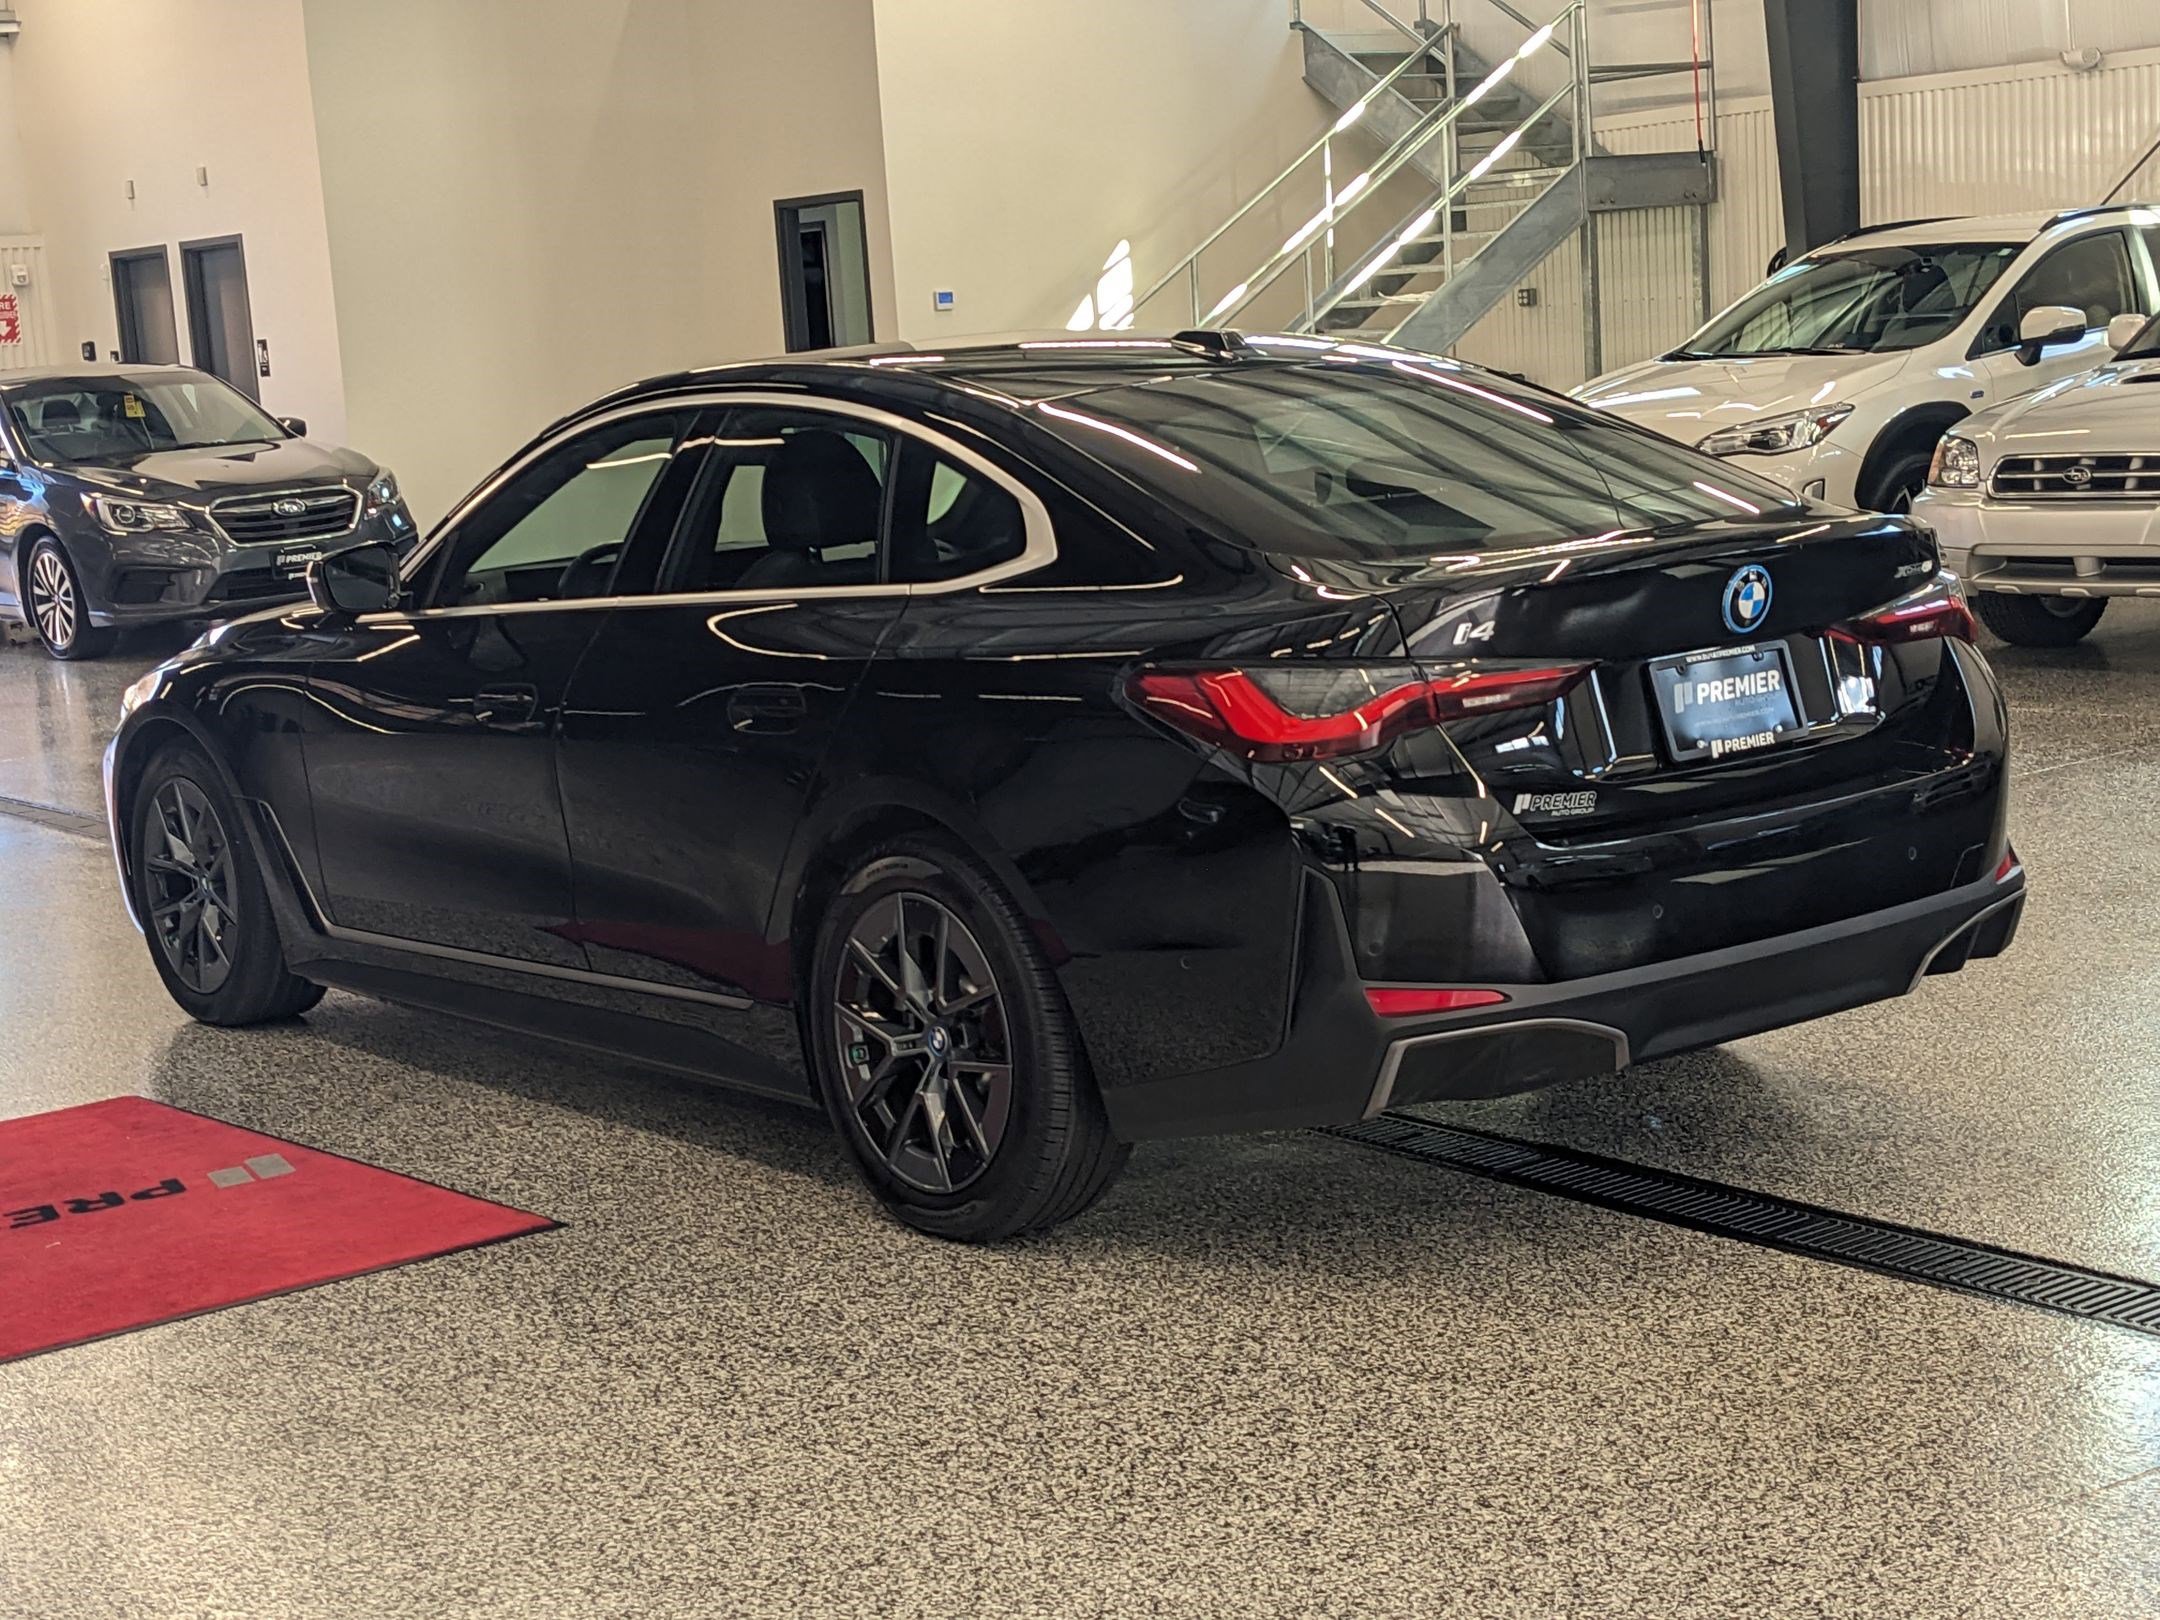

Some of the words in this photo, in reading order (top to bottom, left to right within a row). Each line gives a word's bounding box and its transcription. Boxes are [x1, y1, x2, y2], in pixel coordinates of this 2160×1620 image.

[1453, 620, 1496, 645] i4
[1696, 669, 1781, 705] PREMIER
[1724, 731, 1776, 753] PREMIER
[1529, 790, 1598, 812] PREMIER
[1551, 809, 1570, 817] AUTO
[3, 1178, 187, 1229] PRE
